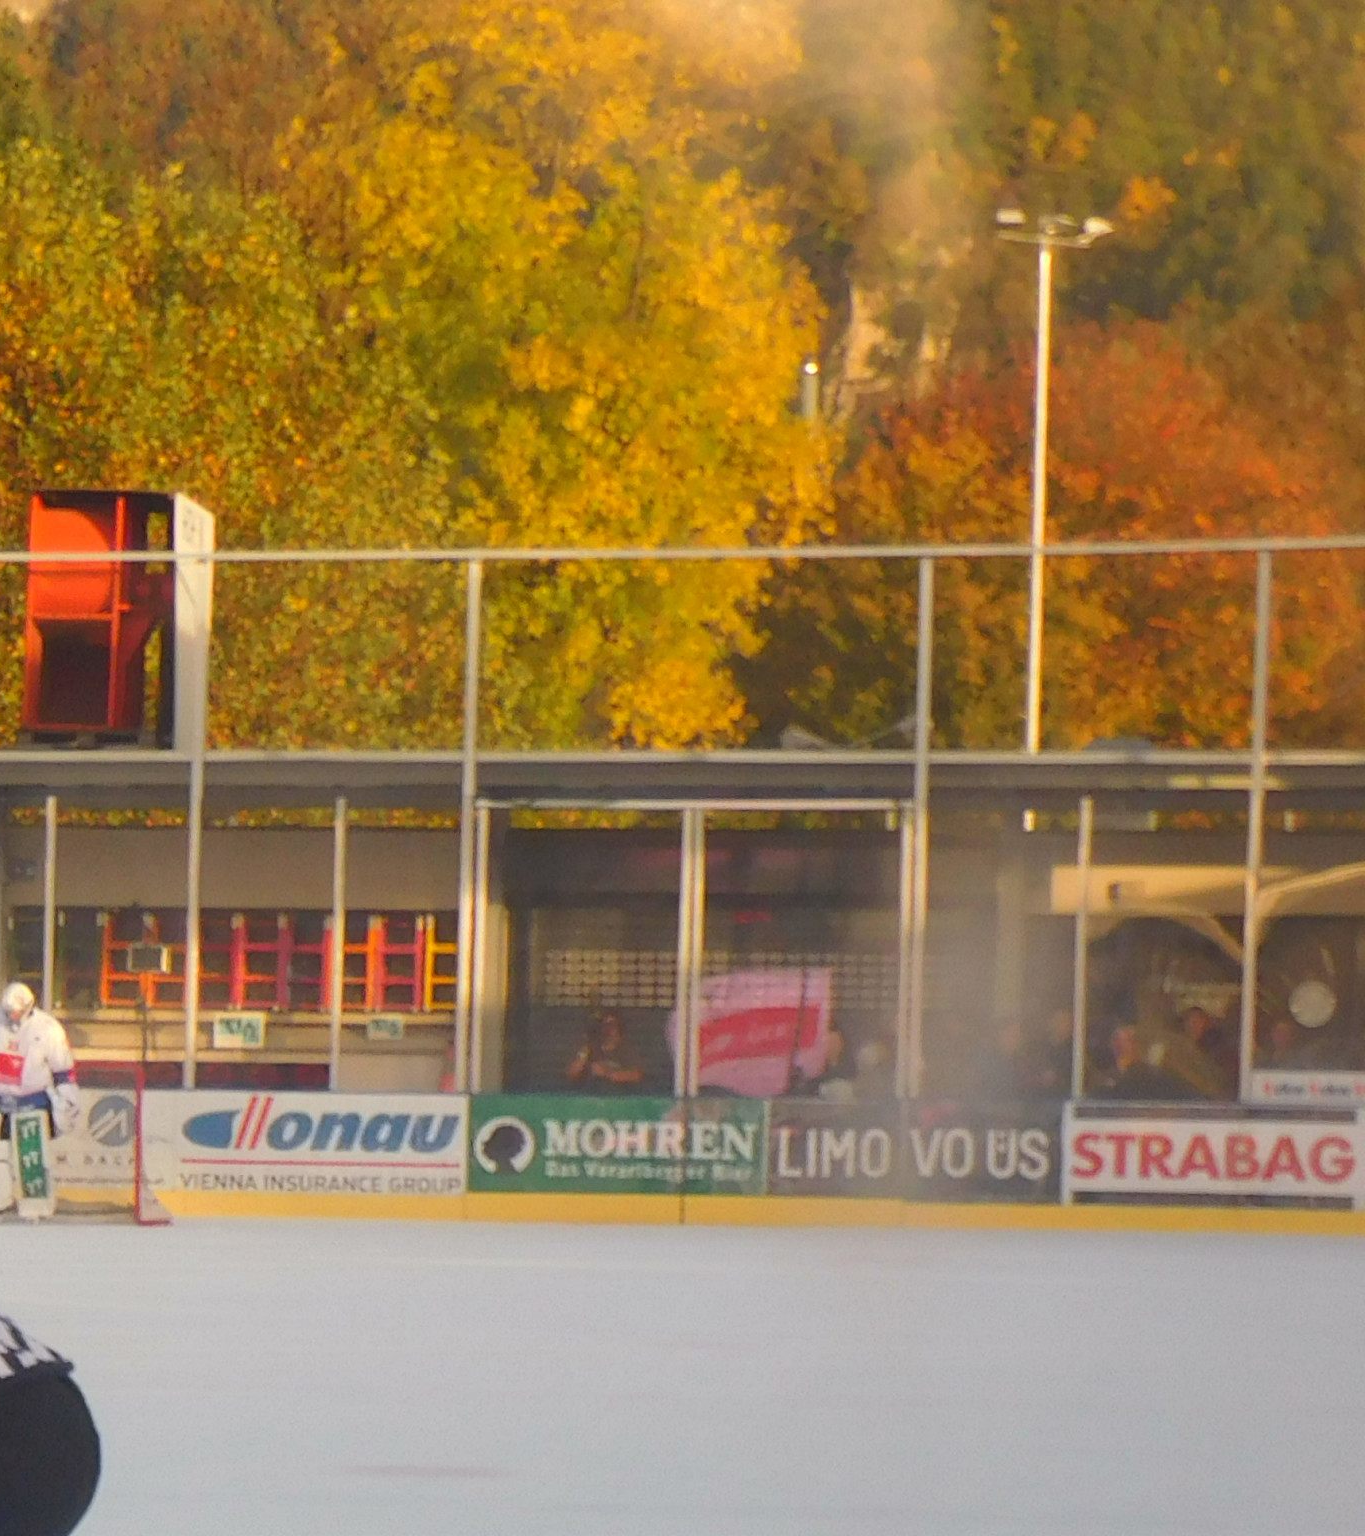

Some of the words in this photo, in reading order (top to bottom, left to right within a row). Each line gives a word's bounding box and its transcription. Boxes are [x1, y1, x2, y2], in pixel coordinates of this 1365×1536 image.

[543, 1118, 759, 1161] MOHREN
[777, 1127, 893, 1179] LIMO
[909, 1127, 976, 1179] VO
[1071, 1131, 1357, 1174] STRABAG
[179, 1173, 256, 1190] VIENNA
[262, 1174, 382, 1193] INSURANCE
[387, 1178, 462, 1194] GROUP
